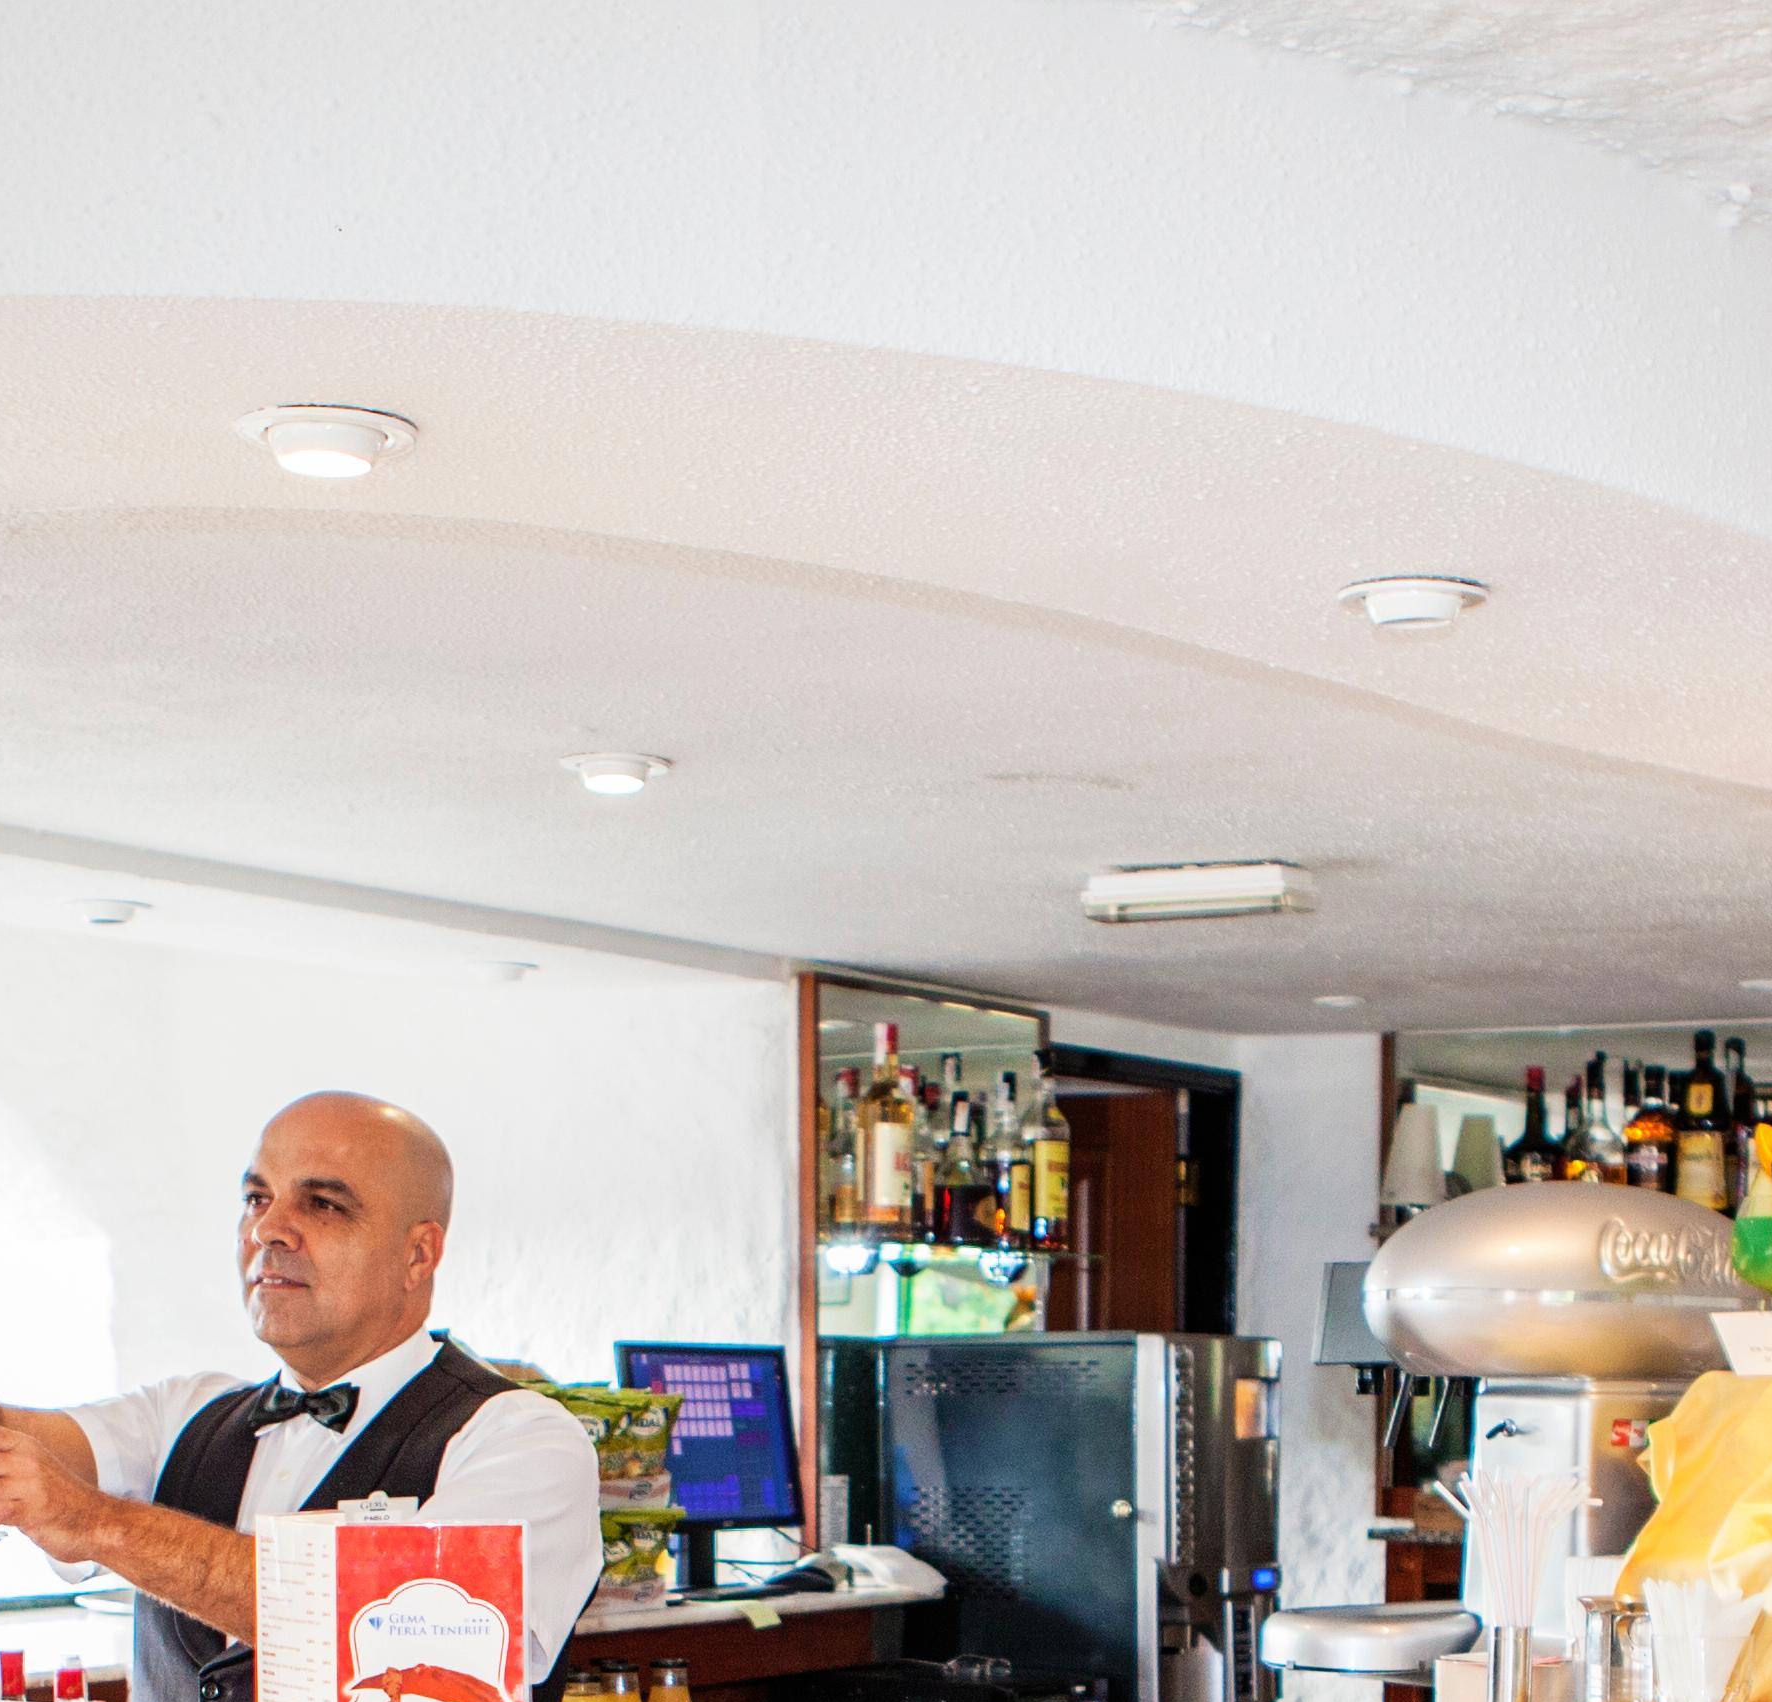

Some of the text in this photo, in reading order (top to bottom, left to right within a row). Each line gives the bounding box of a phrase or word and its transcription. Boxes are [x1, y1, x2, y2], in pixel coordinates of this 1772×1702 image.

[388, 1613, 426, 1625] GEMA
[388, 1625, 491, 1636] PERLA TENERIFE
